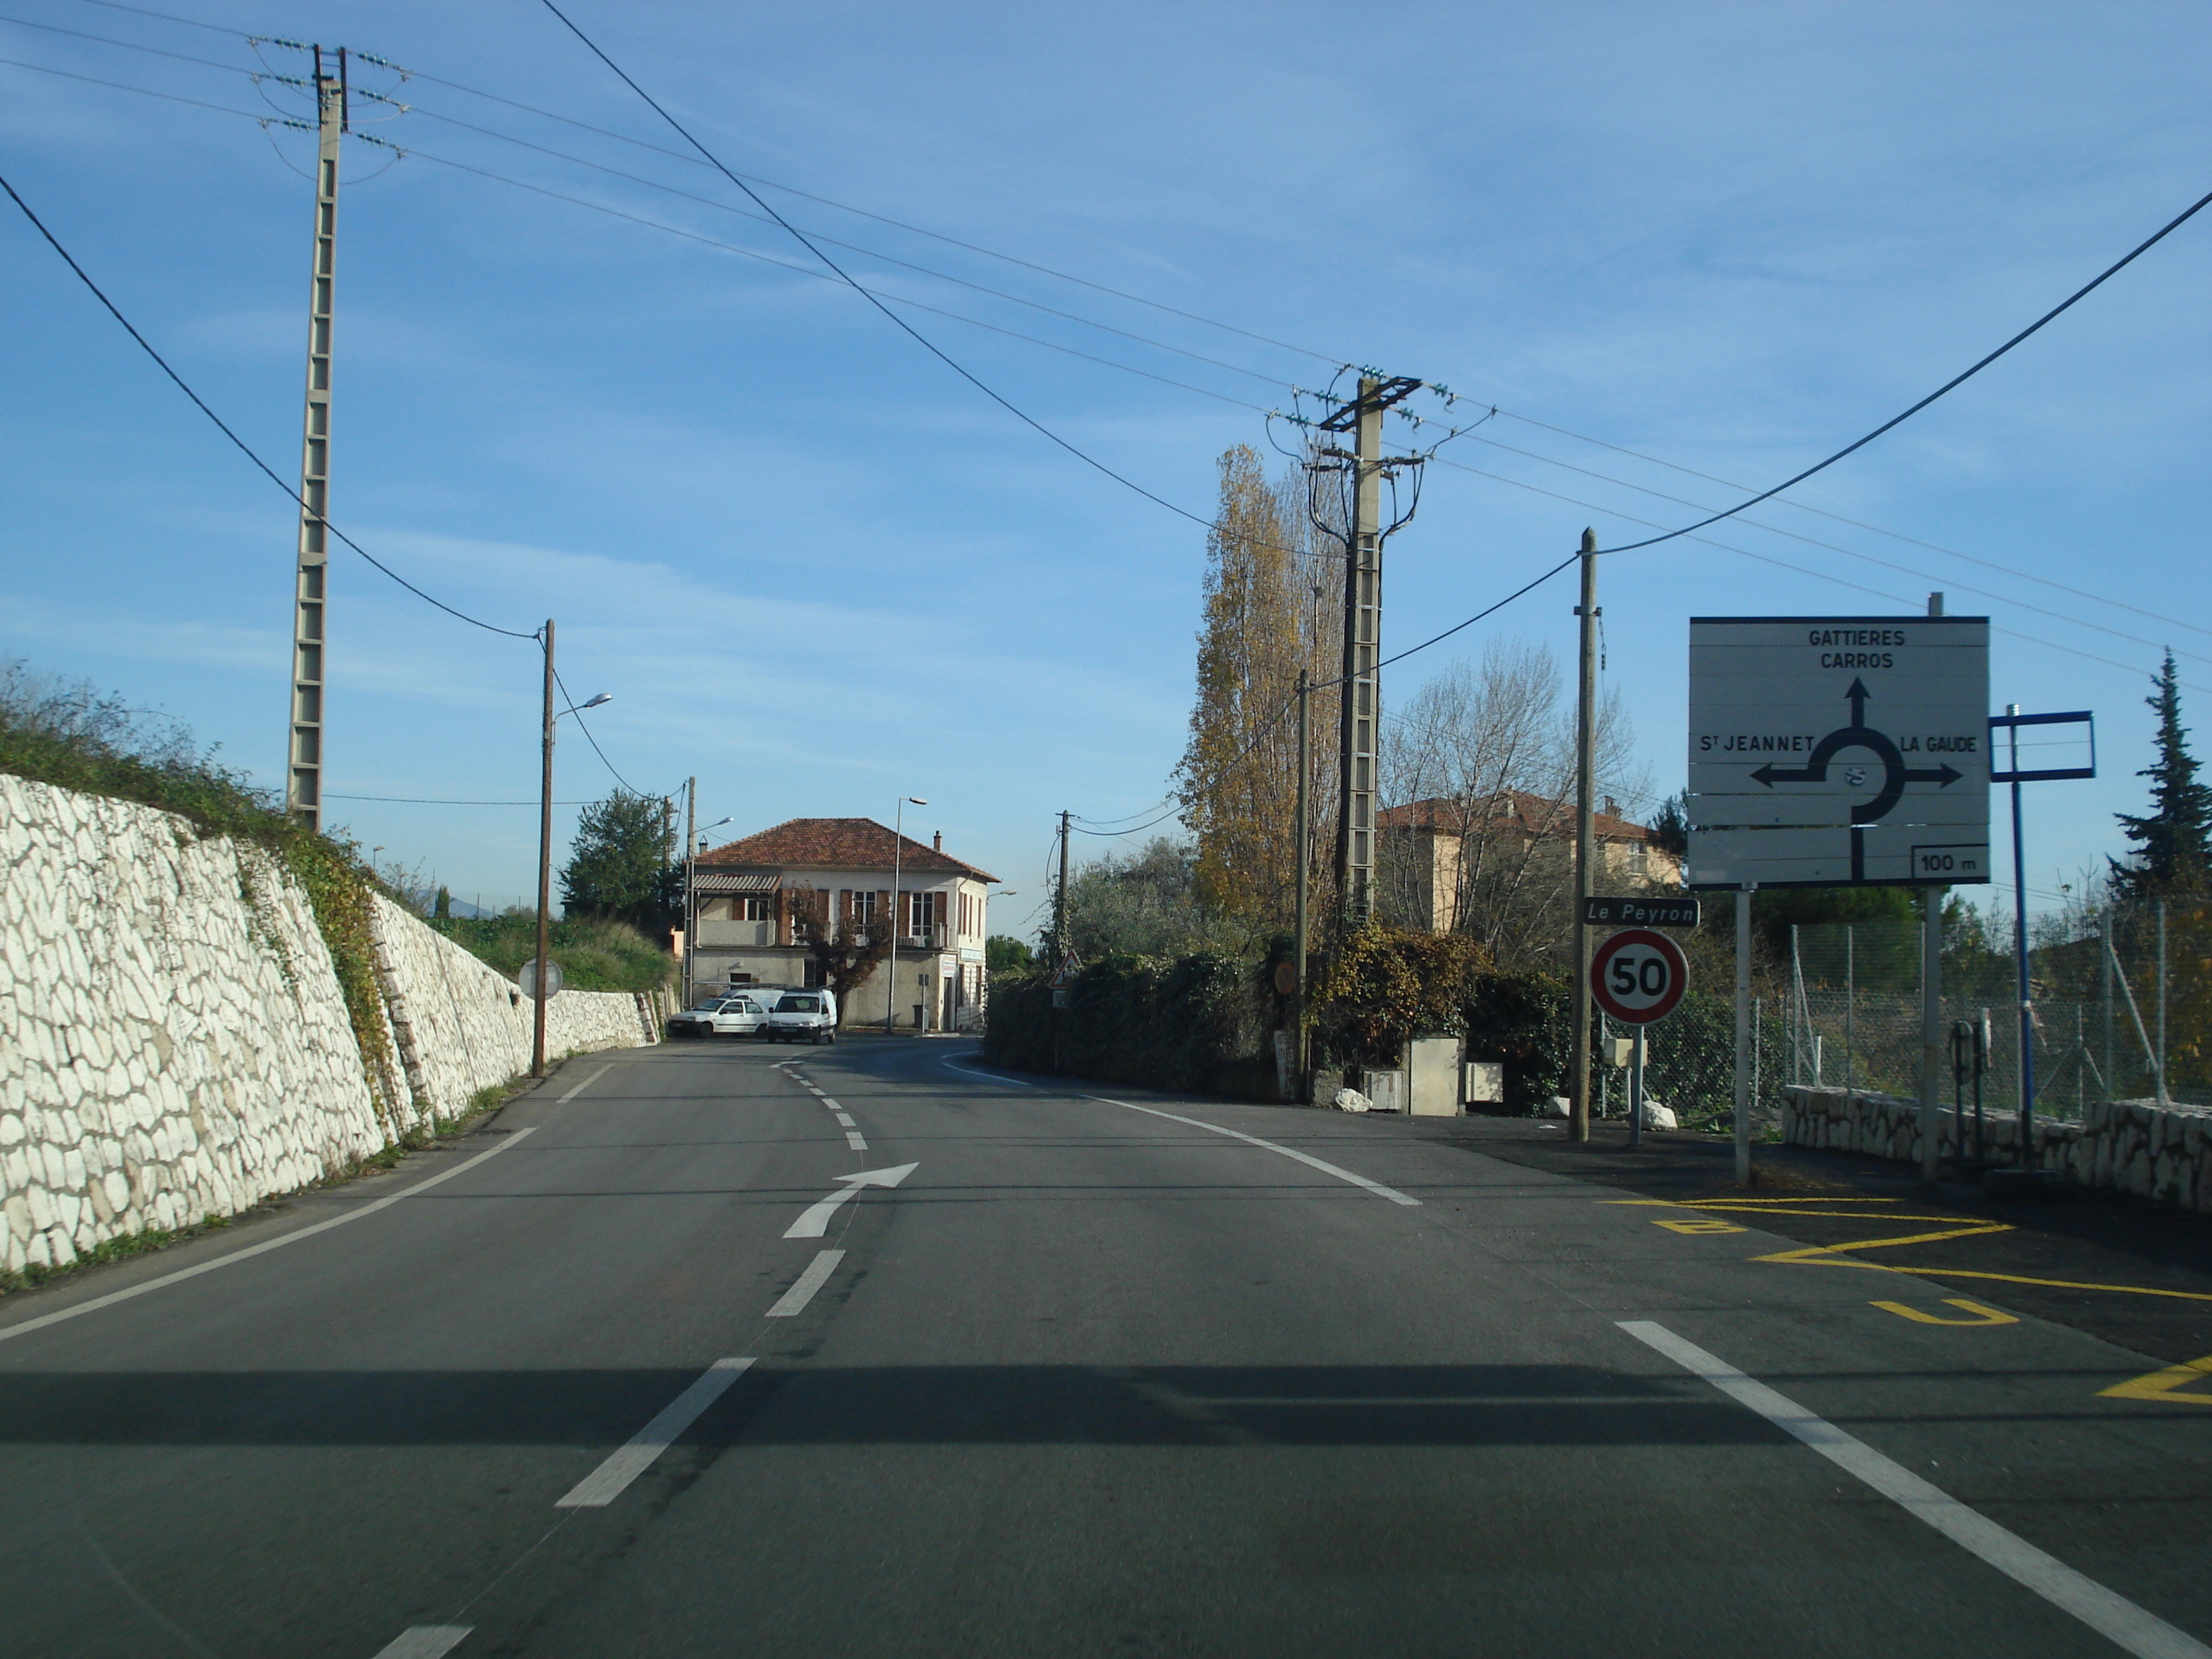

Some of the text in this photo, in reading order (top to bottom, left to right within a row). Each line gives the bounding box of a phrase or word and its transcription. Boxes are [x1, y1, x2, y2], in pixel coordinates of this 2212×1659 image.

[1809, 630, 1905, 647] GATTIERES
[1821, 653, 1893, 669] CARROS
[1724, 736, 1815, 751] JEANNET
[1900, 737, 1976, 752] LA GAUDE
[1921, 855, 1976, 871] 100 m
[1588, 903, 1694, 924] Le Peyron
[1612, 958, 1666, 997] 50
